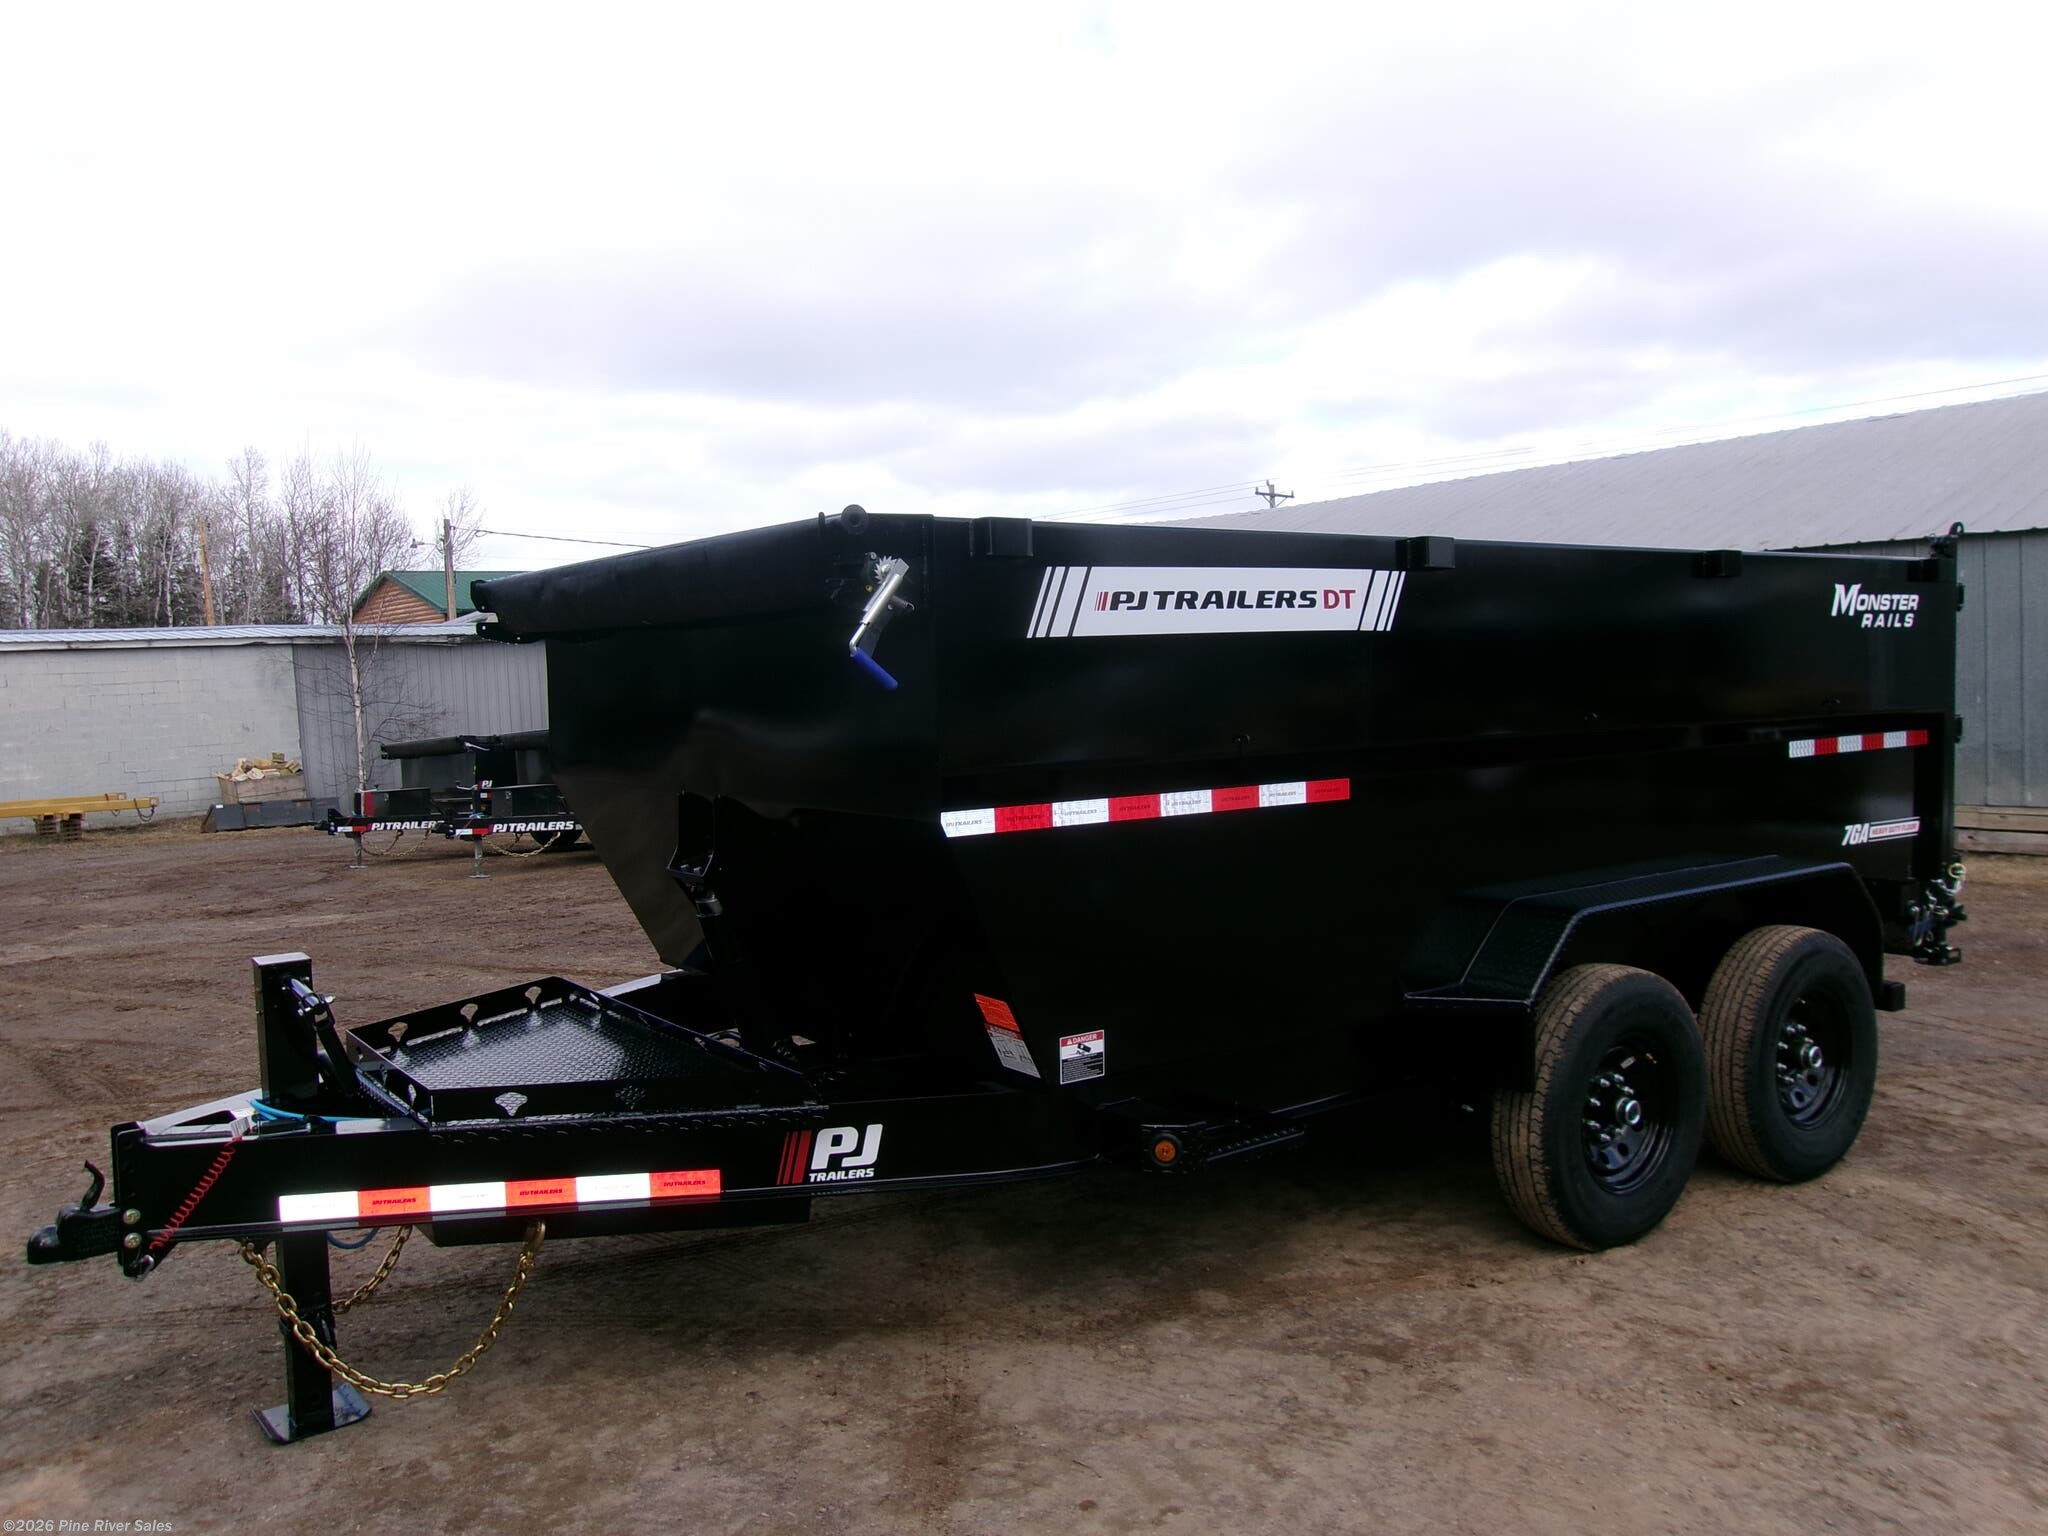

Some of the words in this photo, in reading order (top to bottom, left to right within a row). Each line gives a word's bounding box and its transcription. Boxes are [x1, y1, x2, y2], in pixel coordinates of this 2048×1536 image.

[1322, 589, 1356, 610] DT
[1861, 613, 1915, 629] RAILS
[481, 780, 493, 789] PJ
[386, 820, 445, 831] TRAILER
[1841, 822, 1871, 847] 7GA
[1072, 1033, 1098, 1044] DANGER
[810, 1123, 884, 1171] PJ
[808, 1167, 875, 1183] TRAILERS
